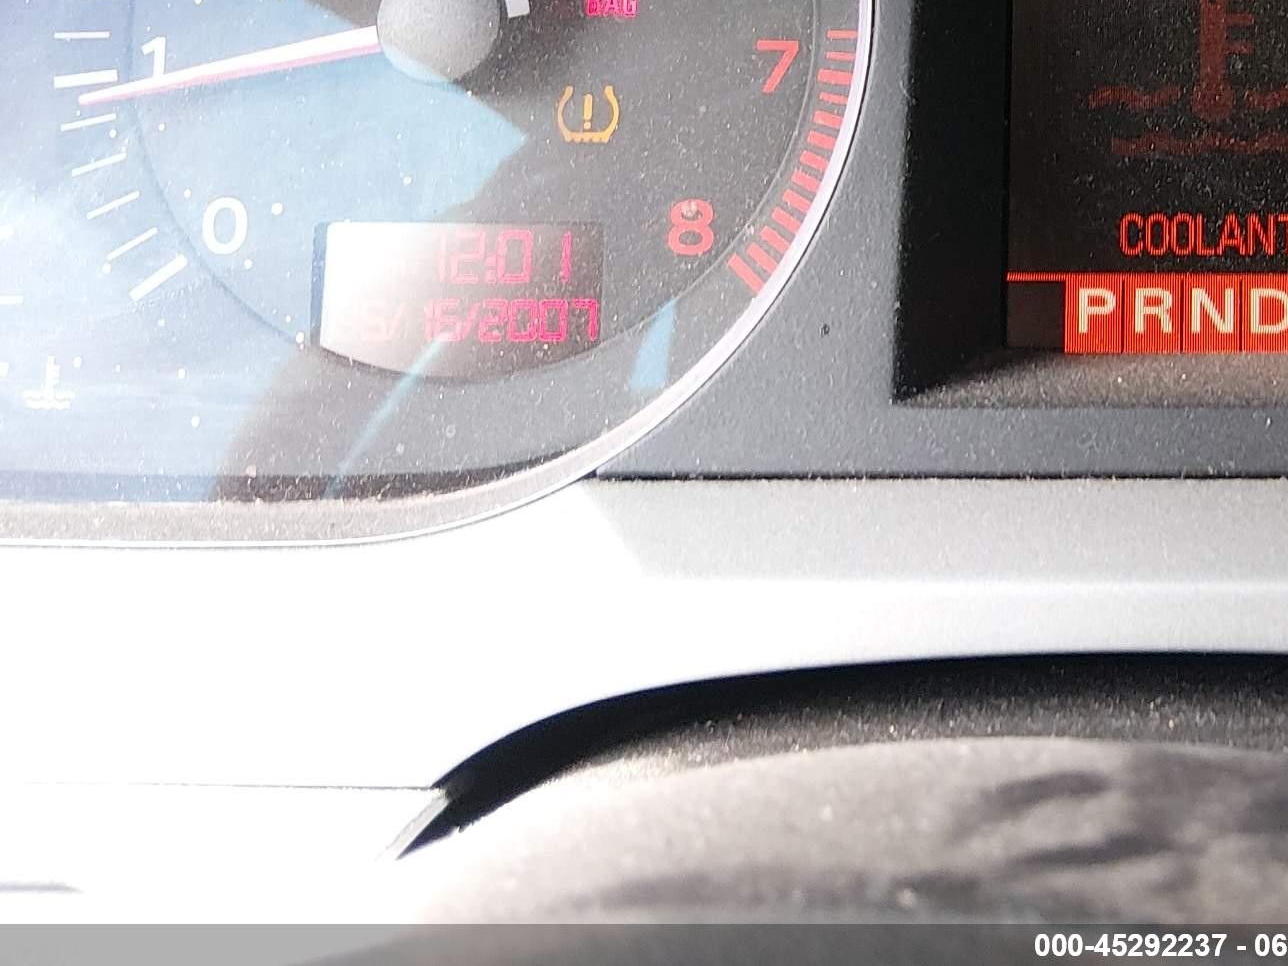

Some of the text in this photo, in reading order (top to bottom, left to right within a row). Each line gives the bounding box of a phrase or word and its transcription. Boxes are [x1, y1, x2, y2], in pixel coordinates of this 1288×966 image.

[141, 37, 167, 79] 1
[757, 40, 799, 92] 7
[203, 198, 247, 254] 0
[668, 201, 713, 254] 8
